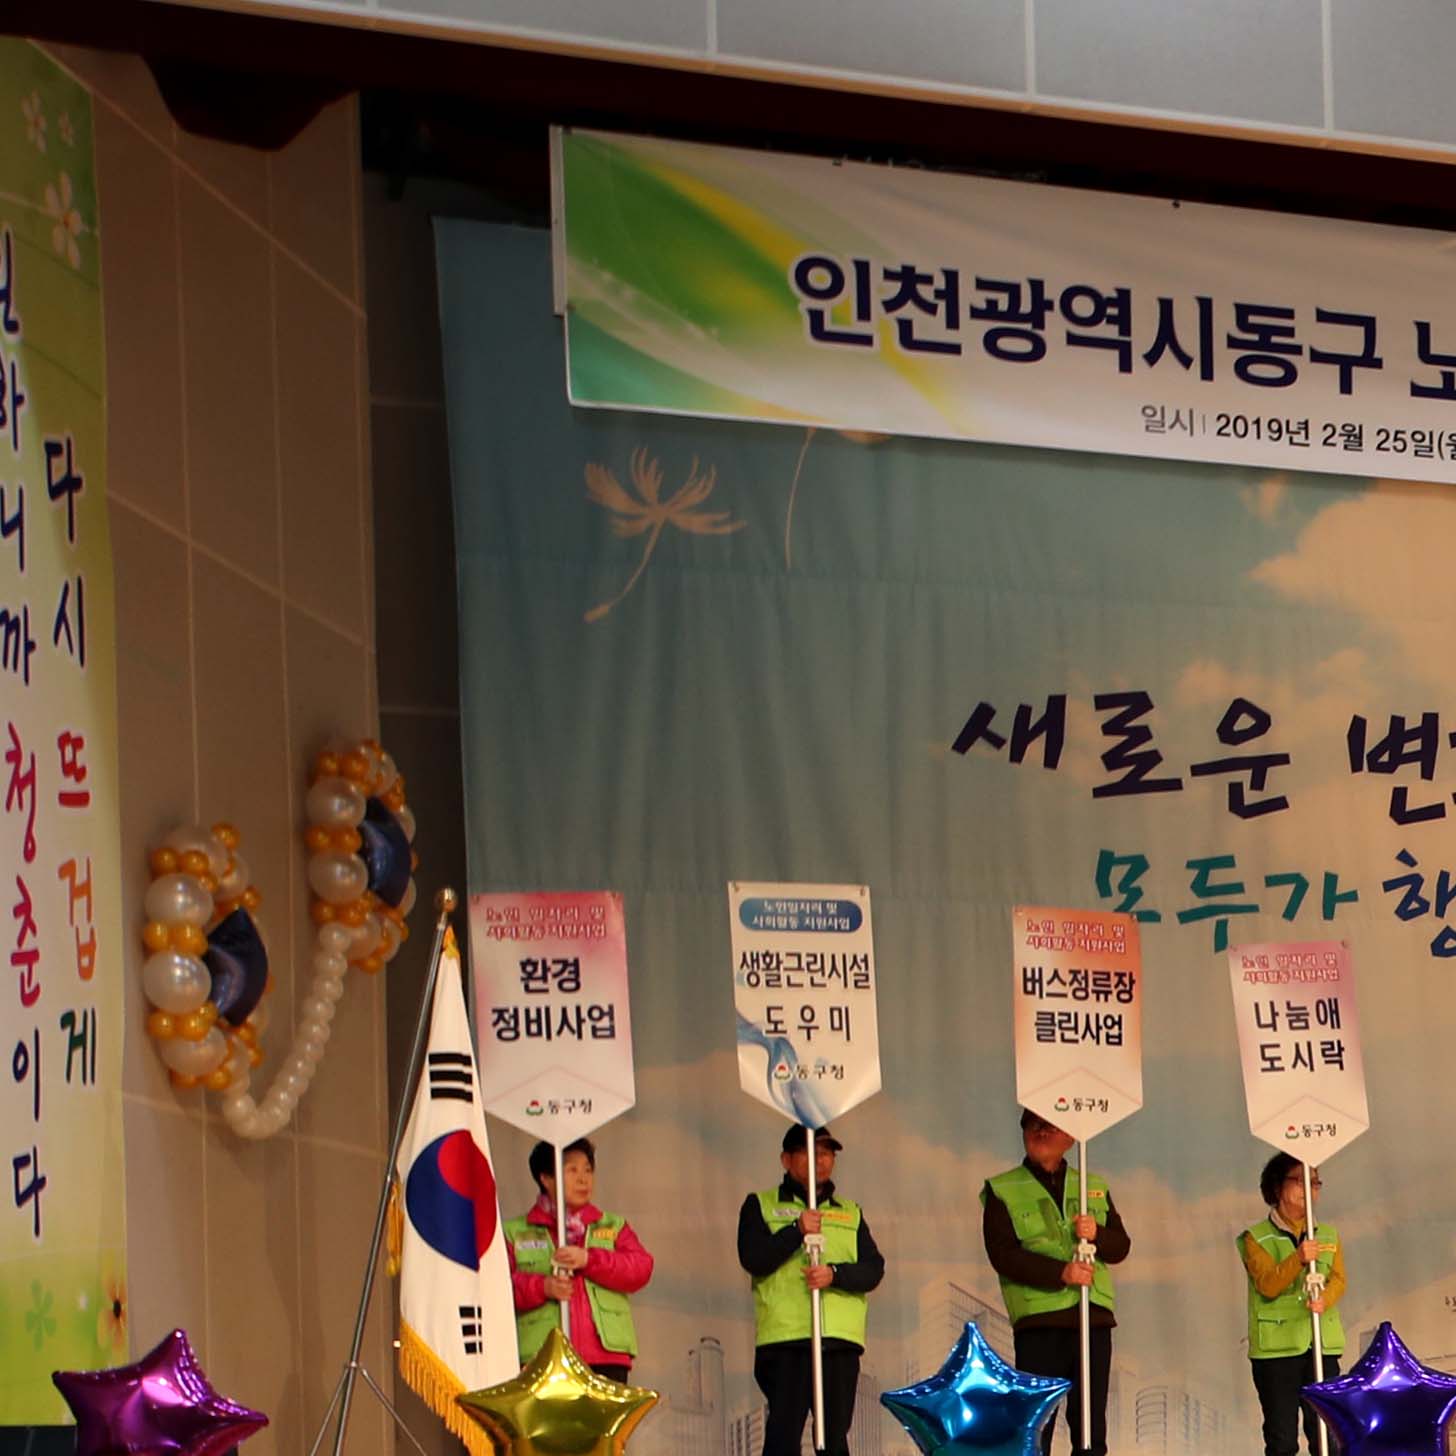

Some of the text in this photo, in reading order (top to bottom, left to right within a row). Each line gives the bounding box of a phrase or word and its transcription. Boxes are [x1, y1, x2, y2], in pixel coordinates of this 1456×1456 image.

[791, 255, 1384, 396] 인천광역시동구
[1140, 405, 1196, 436] 일시
[1215, 413, 1311, 447] 2019년
[1322, 423, 1364, 453] 2월
[44, 434, 87, 670] 다시
[952, 690, 1292, 823] 새로운
[1093, 847, 1360, 952] 모두가
[519, 957, 581, 994] 환경
[739, 951, 871, 989] 생활근린시설
[1023, 966, 1136, 1004] 버스정류장
[491, 1004, 616, 1041] 정비사업
[765, 1005, 851, 1041] 도우미
[1035, 1011, 1123, 1046] 클린사업
[1254, 998, 1341, 1032] 나눔애
[796, 1064, 844, 1080] 동구청
[1260, 1039, 1345, 1072] 도시락
[548, 1099, 593, 1114] 동구청
[1073, 1097, 1109, 1112] 동구청
[1302, 1124, 1337, 1138] 동구청
